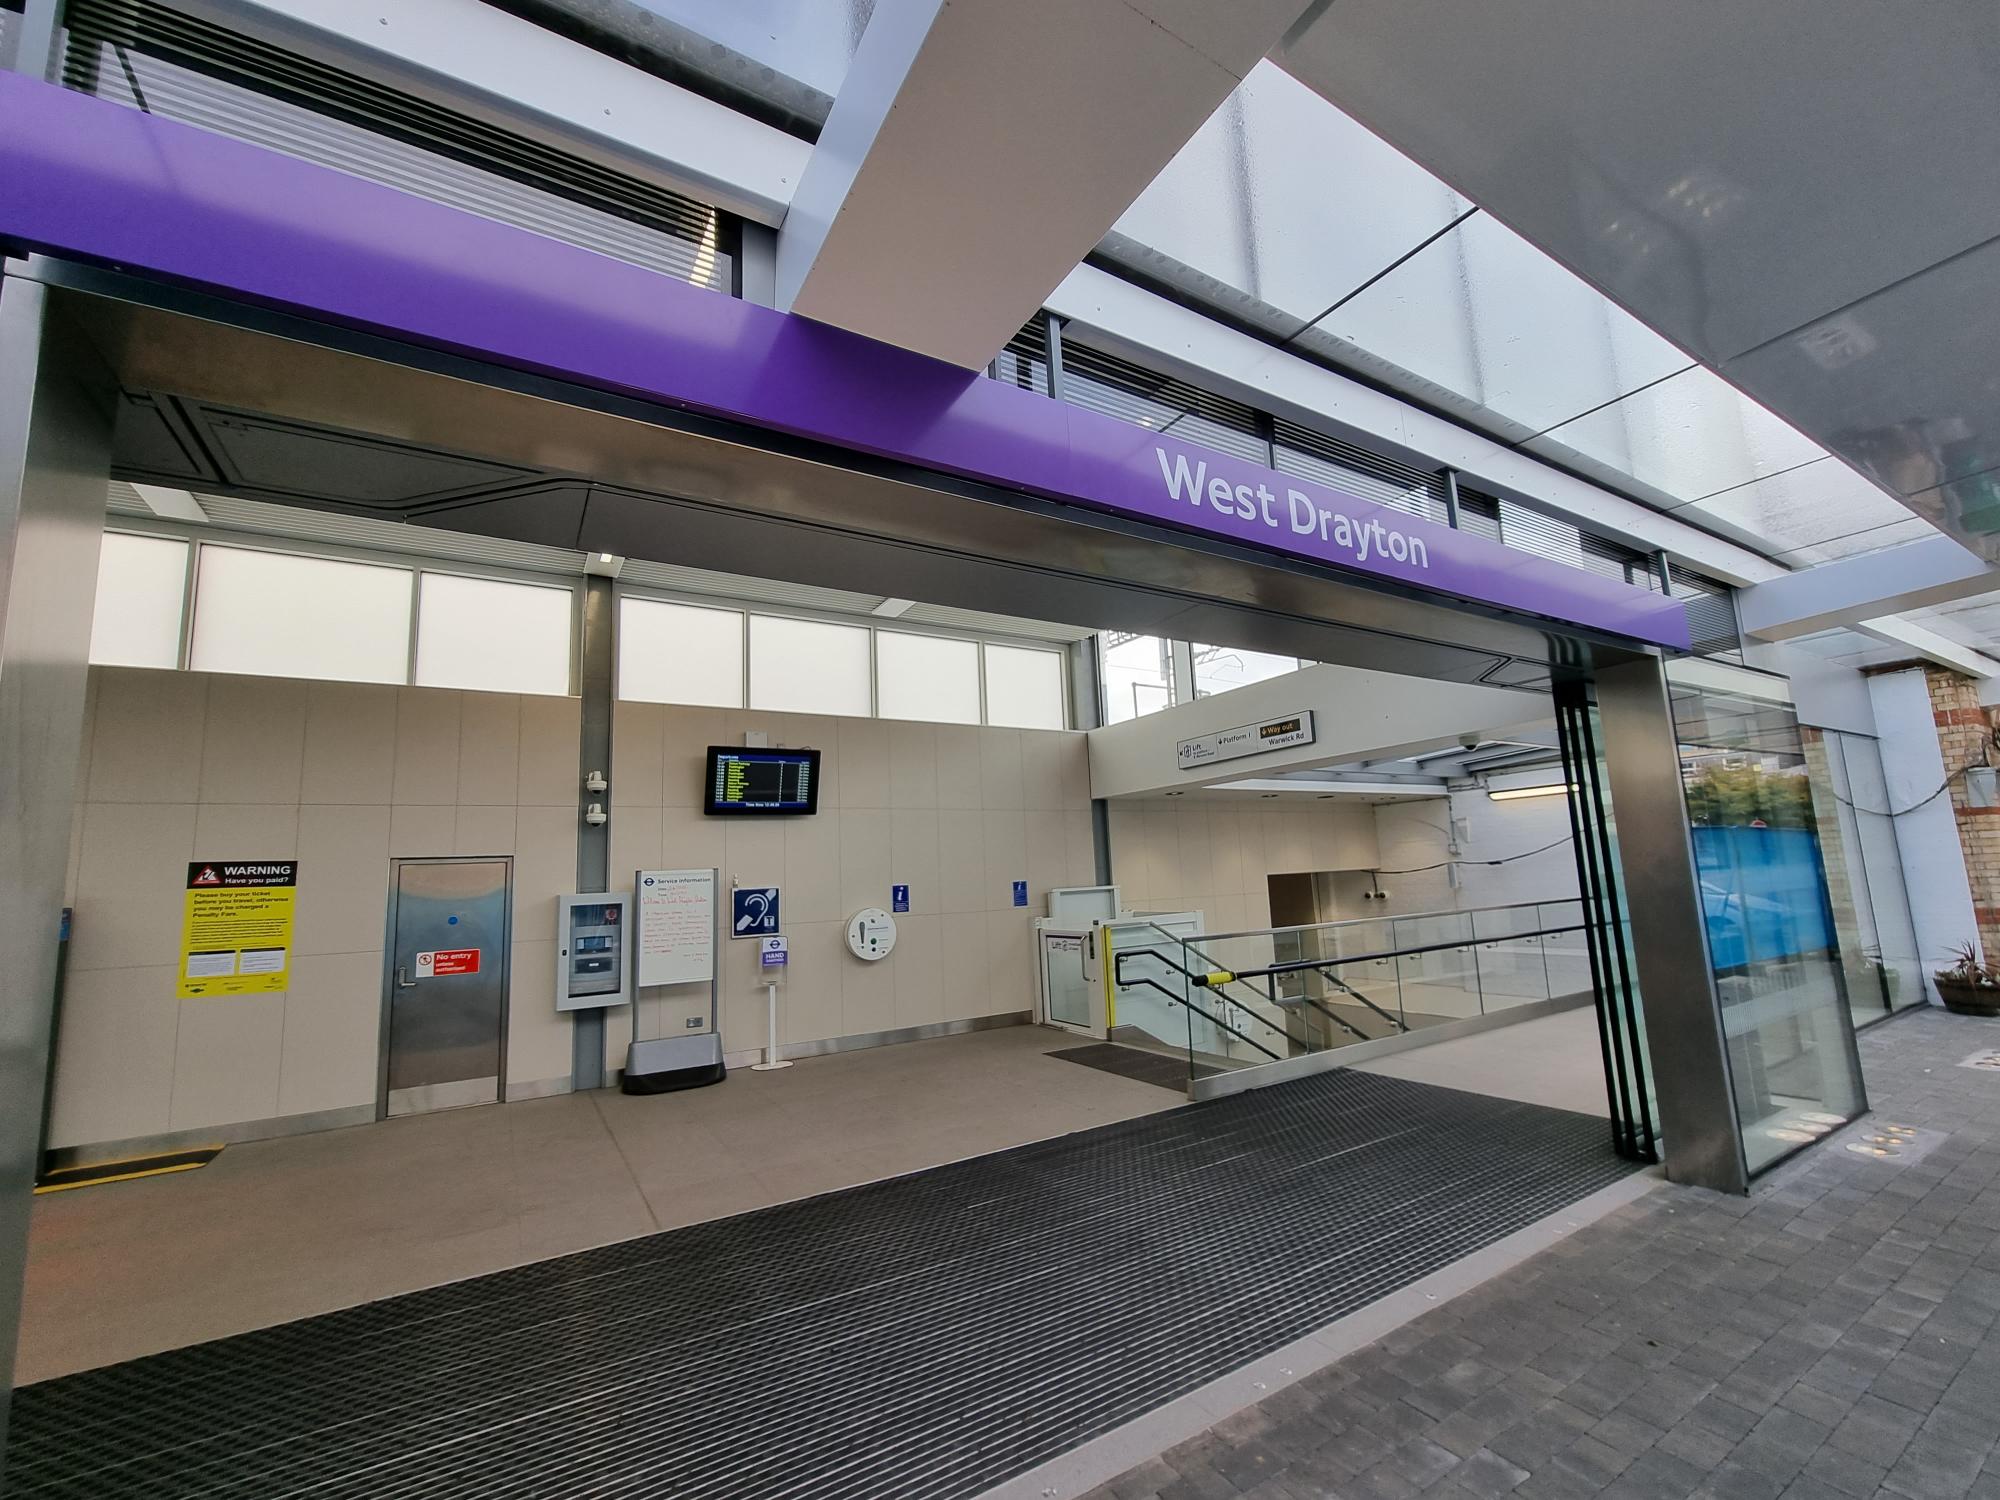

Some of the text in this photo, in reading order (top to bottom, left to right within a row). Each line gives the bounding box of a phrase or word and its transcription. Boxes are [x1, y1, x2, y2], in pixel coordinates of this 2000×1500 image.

[1156, 447, 1429, 568] West Drayton
[1267, 726, 1281, 734] Way
[1223, 734, 1247, 744] Platform
[1268, 732, 1305, 746] Warwick Rd
[1192, 743, 1202, 752] Lift
[223, 865, 291, 876] WARNING
